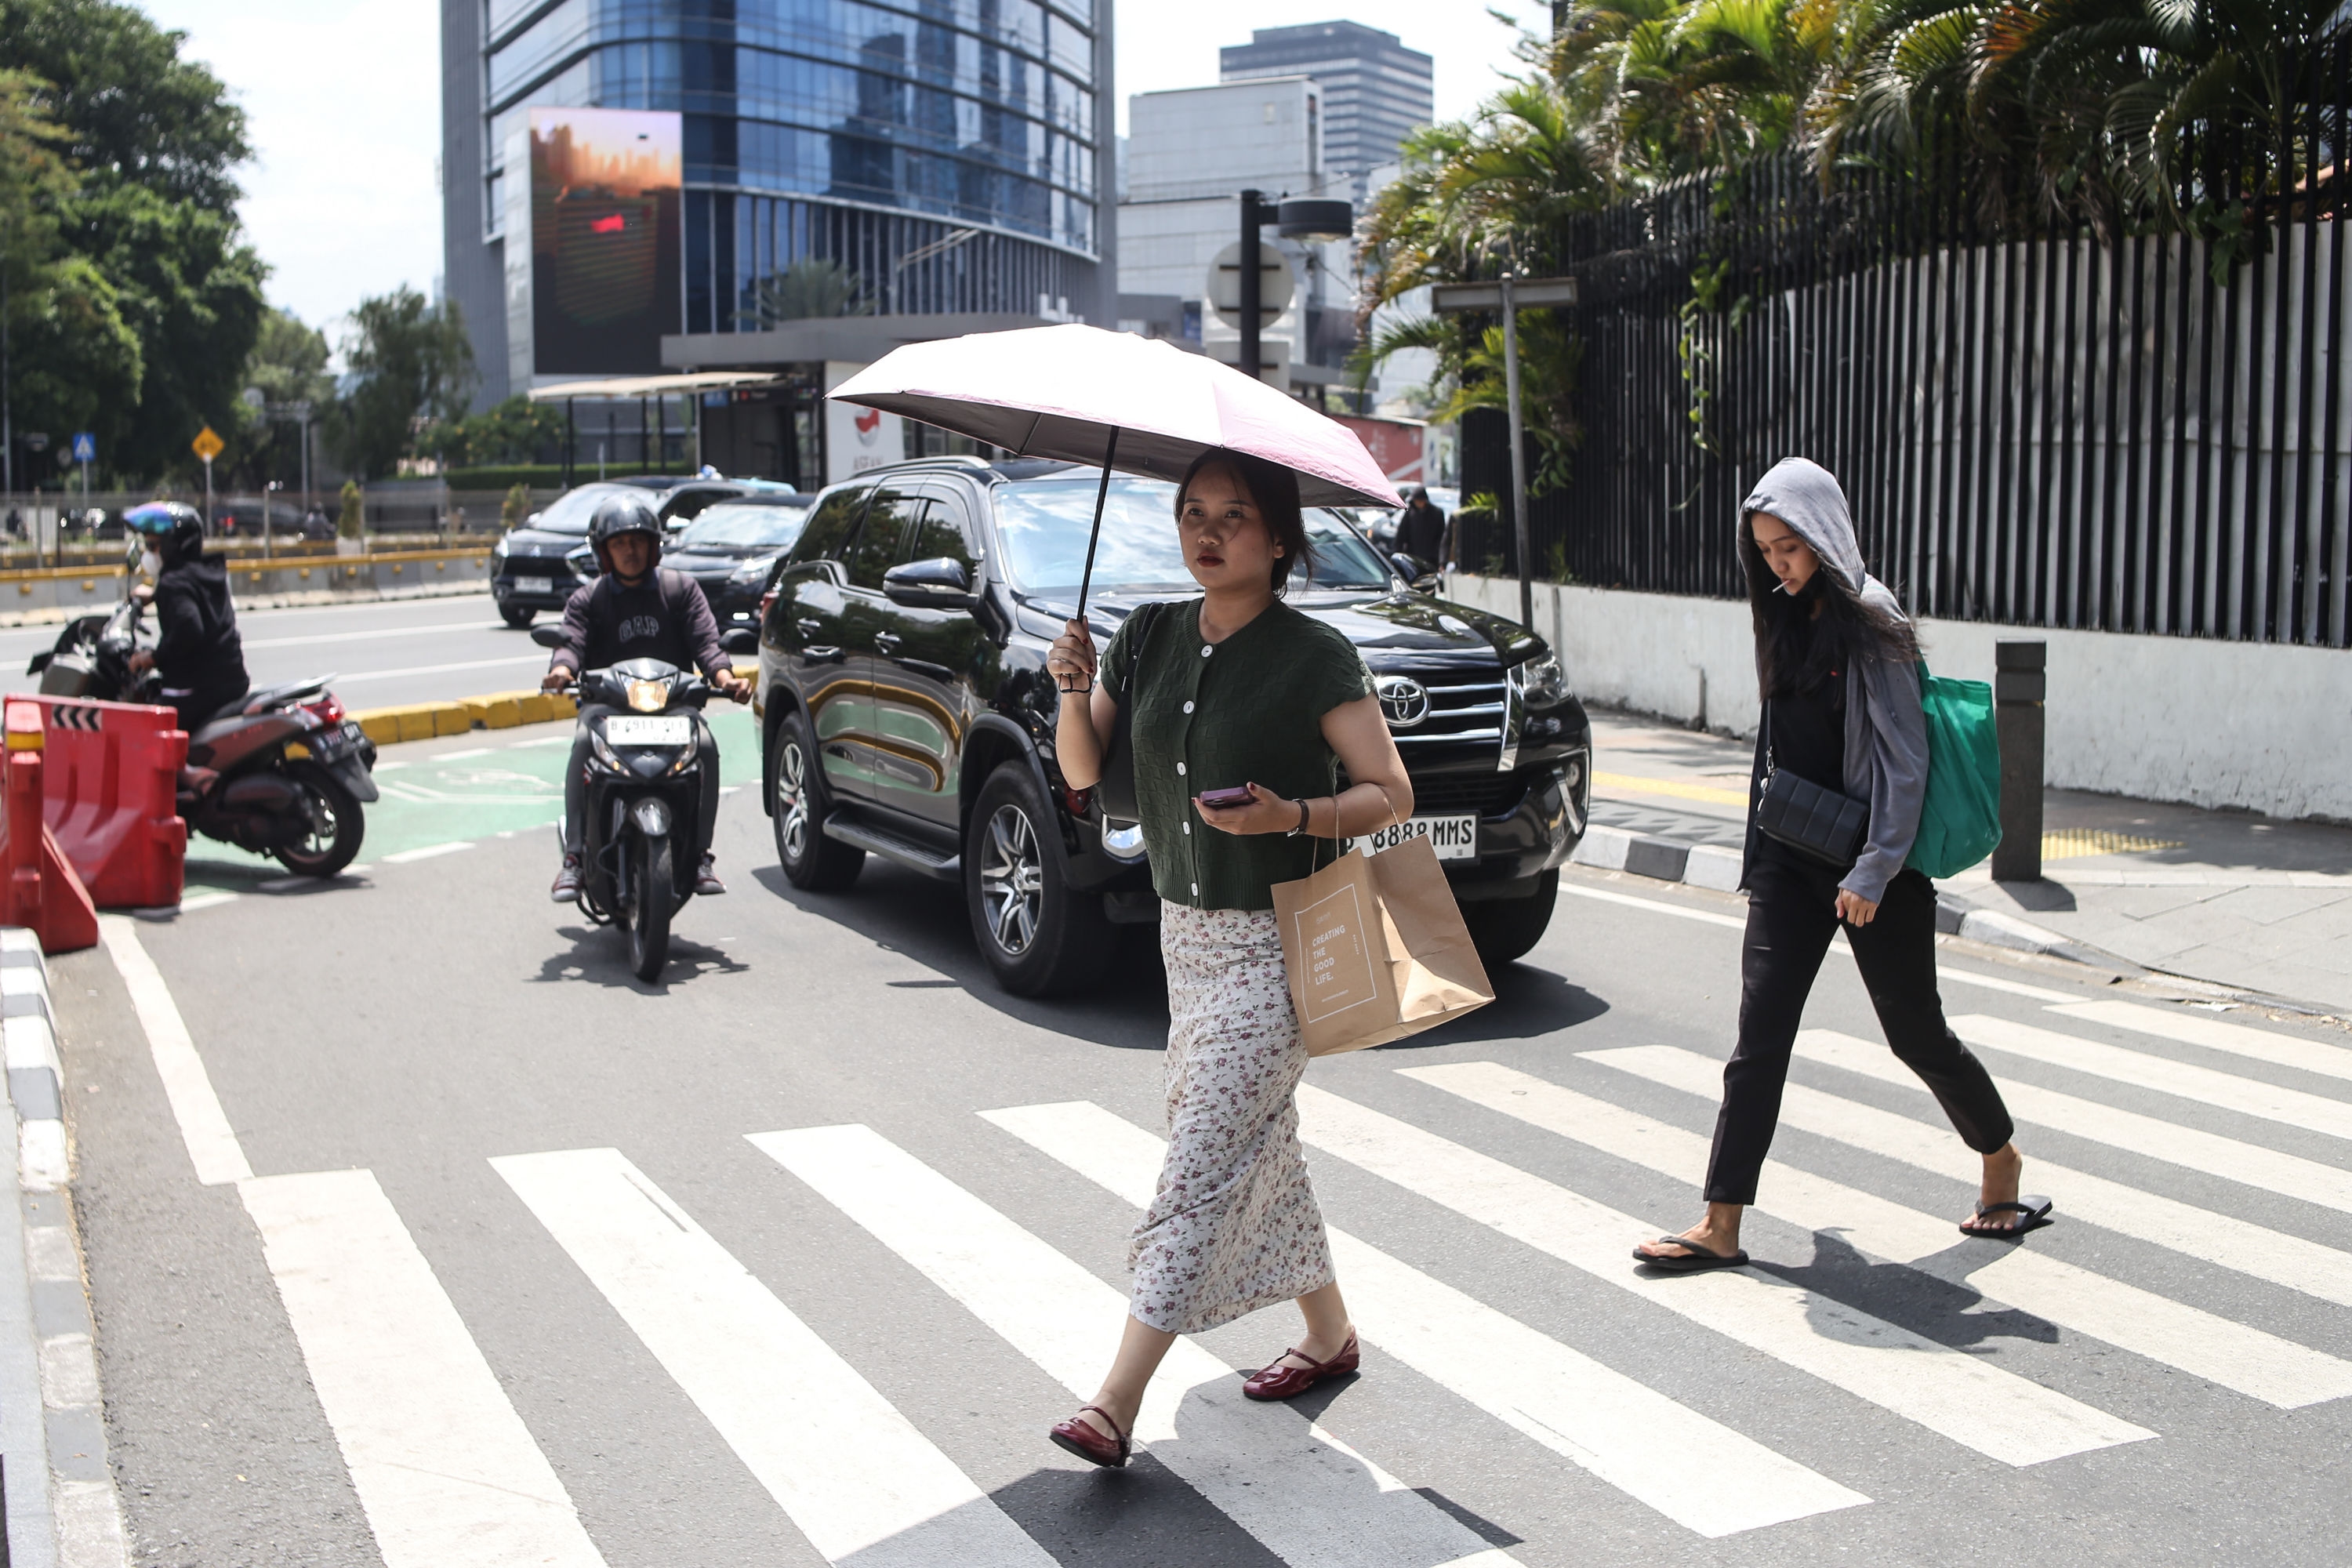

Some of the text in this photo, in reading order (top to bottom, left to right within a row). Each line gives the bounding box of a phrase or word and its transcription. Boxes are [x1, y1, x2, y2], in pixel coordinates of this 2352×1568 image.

[619, 615, 659, 643] GAP
[611, 720, 618, 731] B
[1432, 819, 1472, 846] MMS
[1312, 924, 1346, 946] CREATING
[1312, 947, 1326, 960] THE
[1314, 956, 1334, 972] GOOD
[1315, 971, 1334, 985] LIFE.
